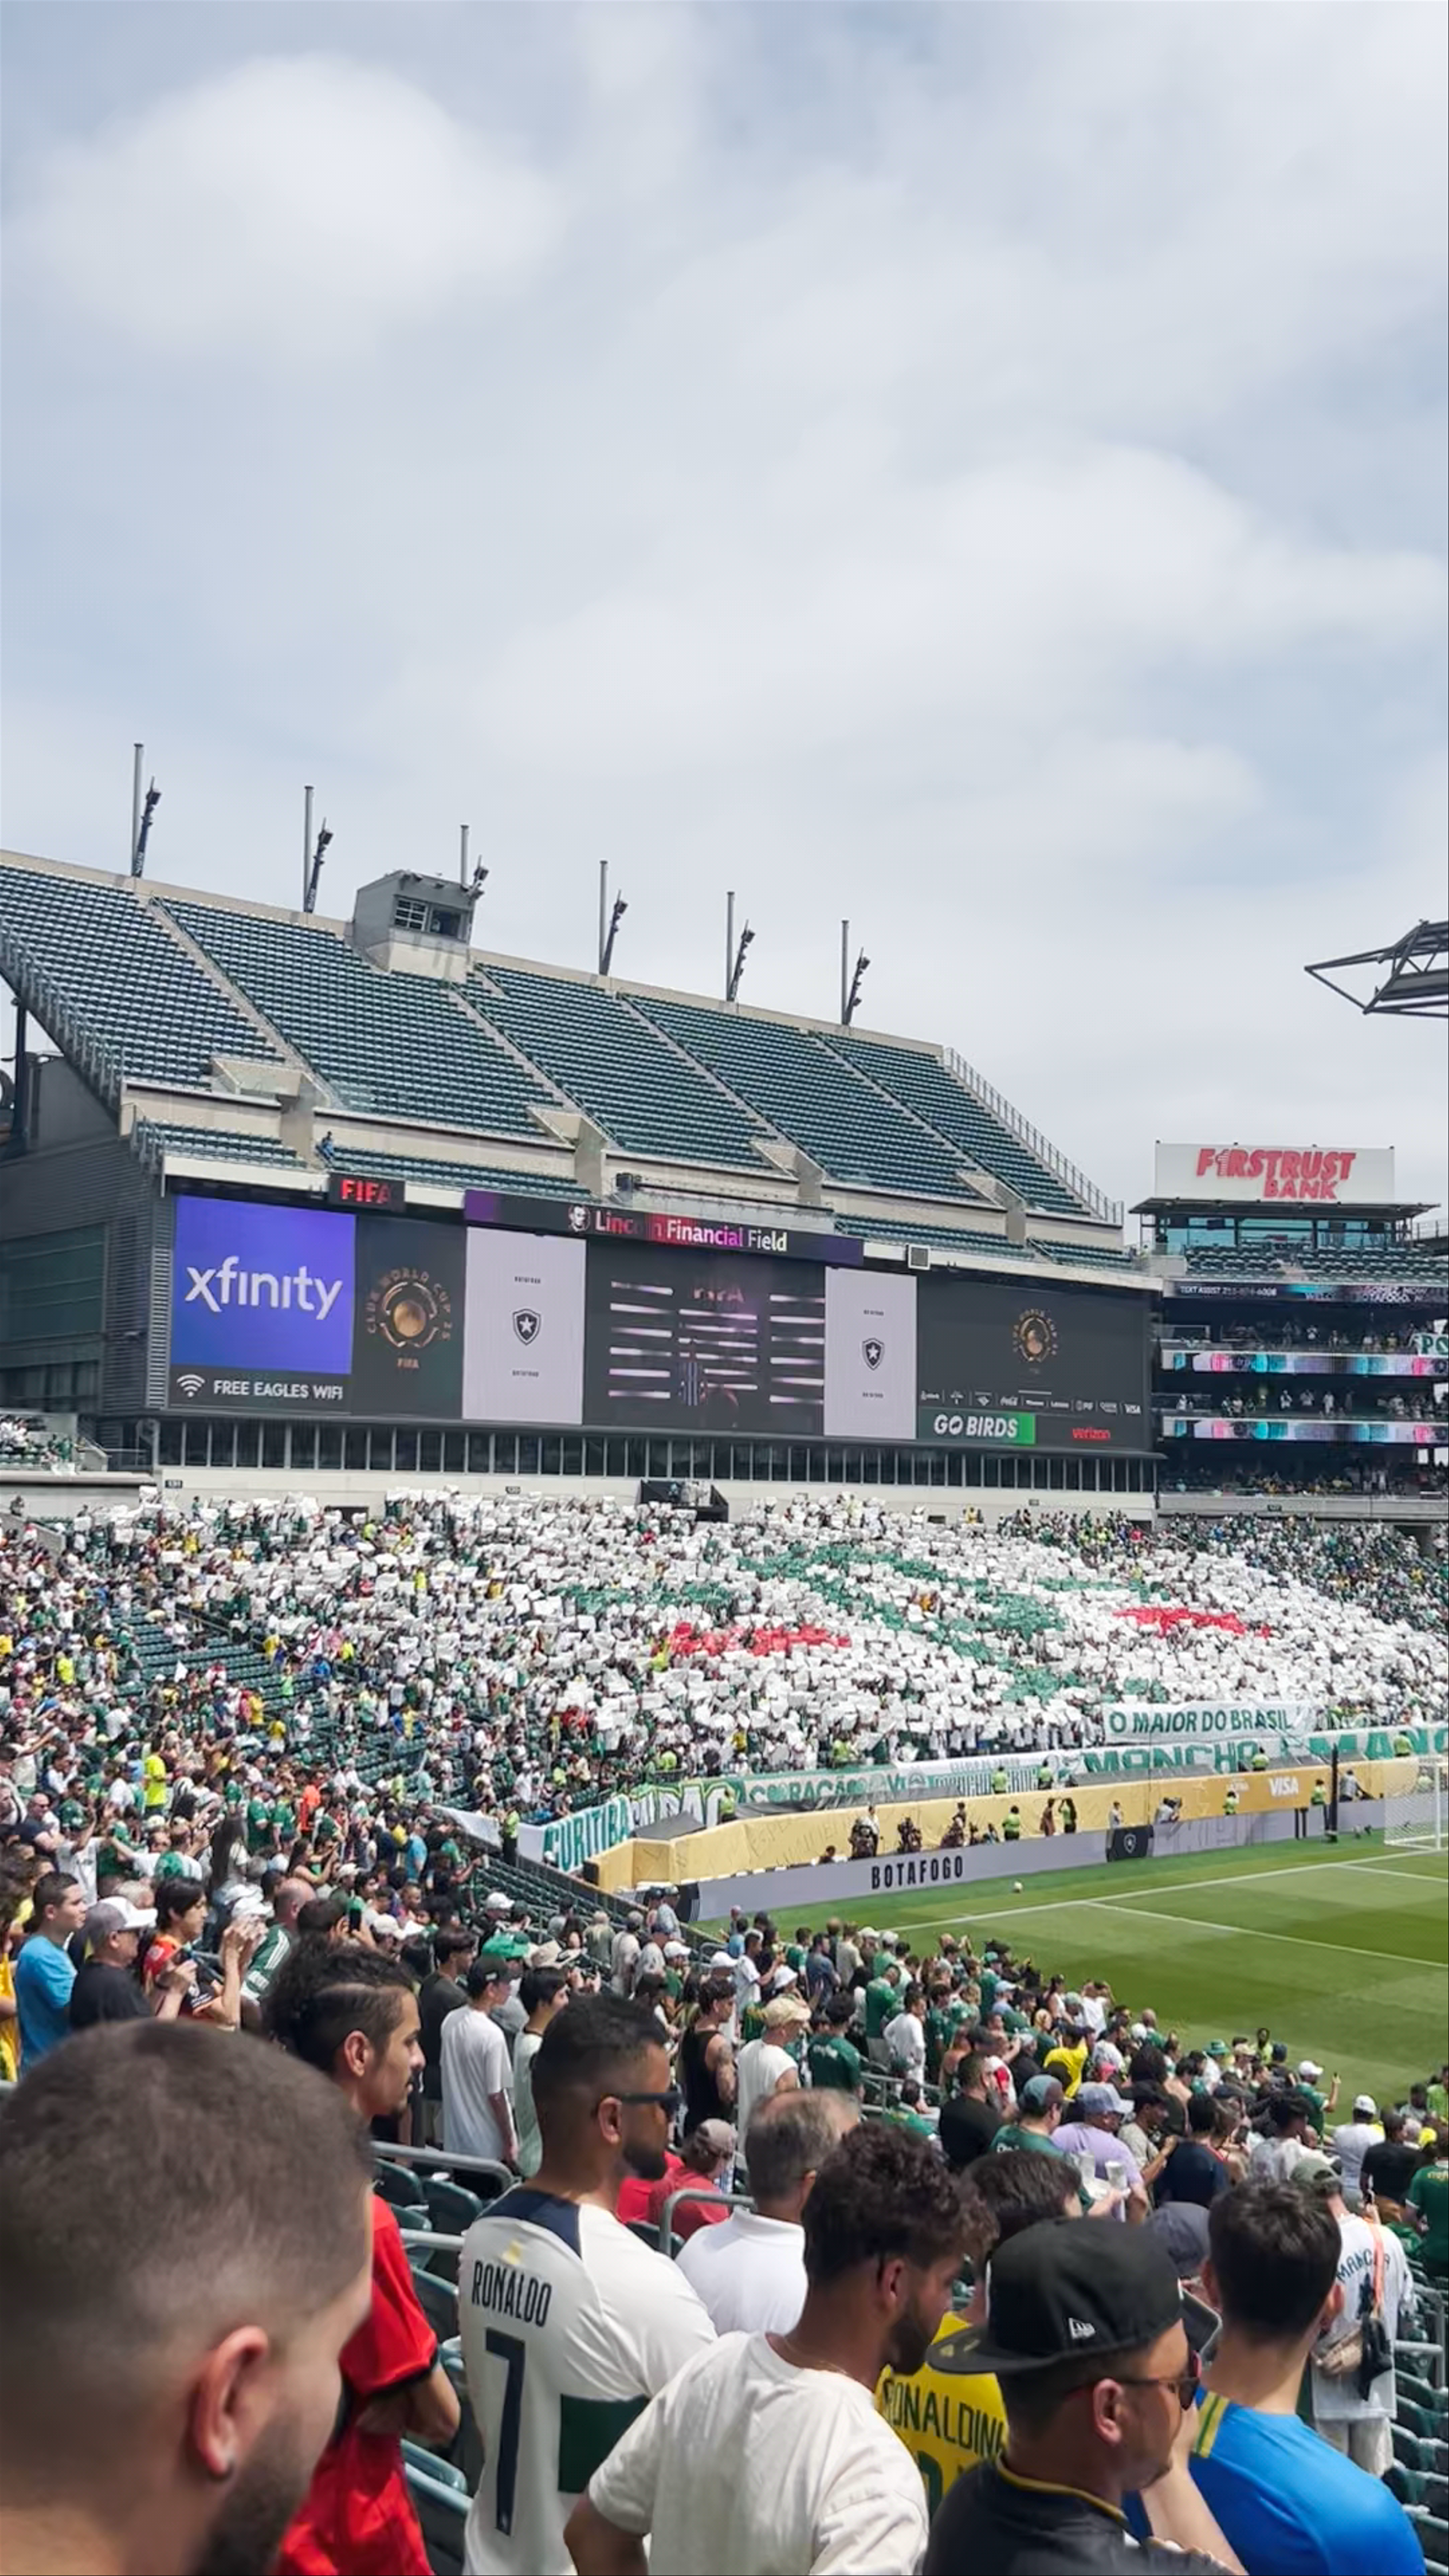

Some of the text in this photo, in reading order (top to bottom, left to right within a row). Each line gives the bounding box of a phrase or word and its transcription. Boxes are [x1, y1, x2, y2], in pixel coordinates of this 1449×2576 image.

[341, 1180, 392, 1203] FIFA
[1264, 1180, 1338, 1199] BANK
[595, 1211, 787, 1251] Lincn Financial Field
[185, 1256, 343, 1320] xfinity
[214, 1381, 343, 1400] FREE EAGLES WIFI
[934, 1414, 1018, 1438] GO BIRDS
[1109, 1709, 1292, 1733] O MAIOR DO BRASIL
[1268, 1776, 1298, 1797] VISA
[544, 1797, 629, 1872] CURITIBA
[872, 1855, 963, 1890] BOTAFOGO
[472, 2260, 552, 2327] RONALDO
[485, 2327, 525, 2537] 7
